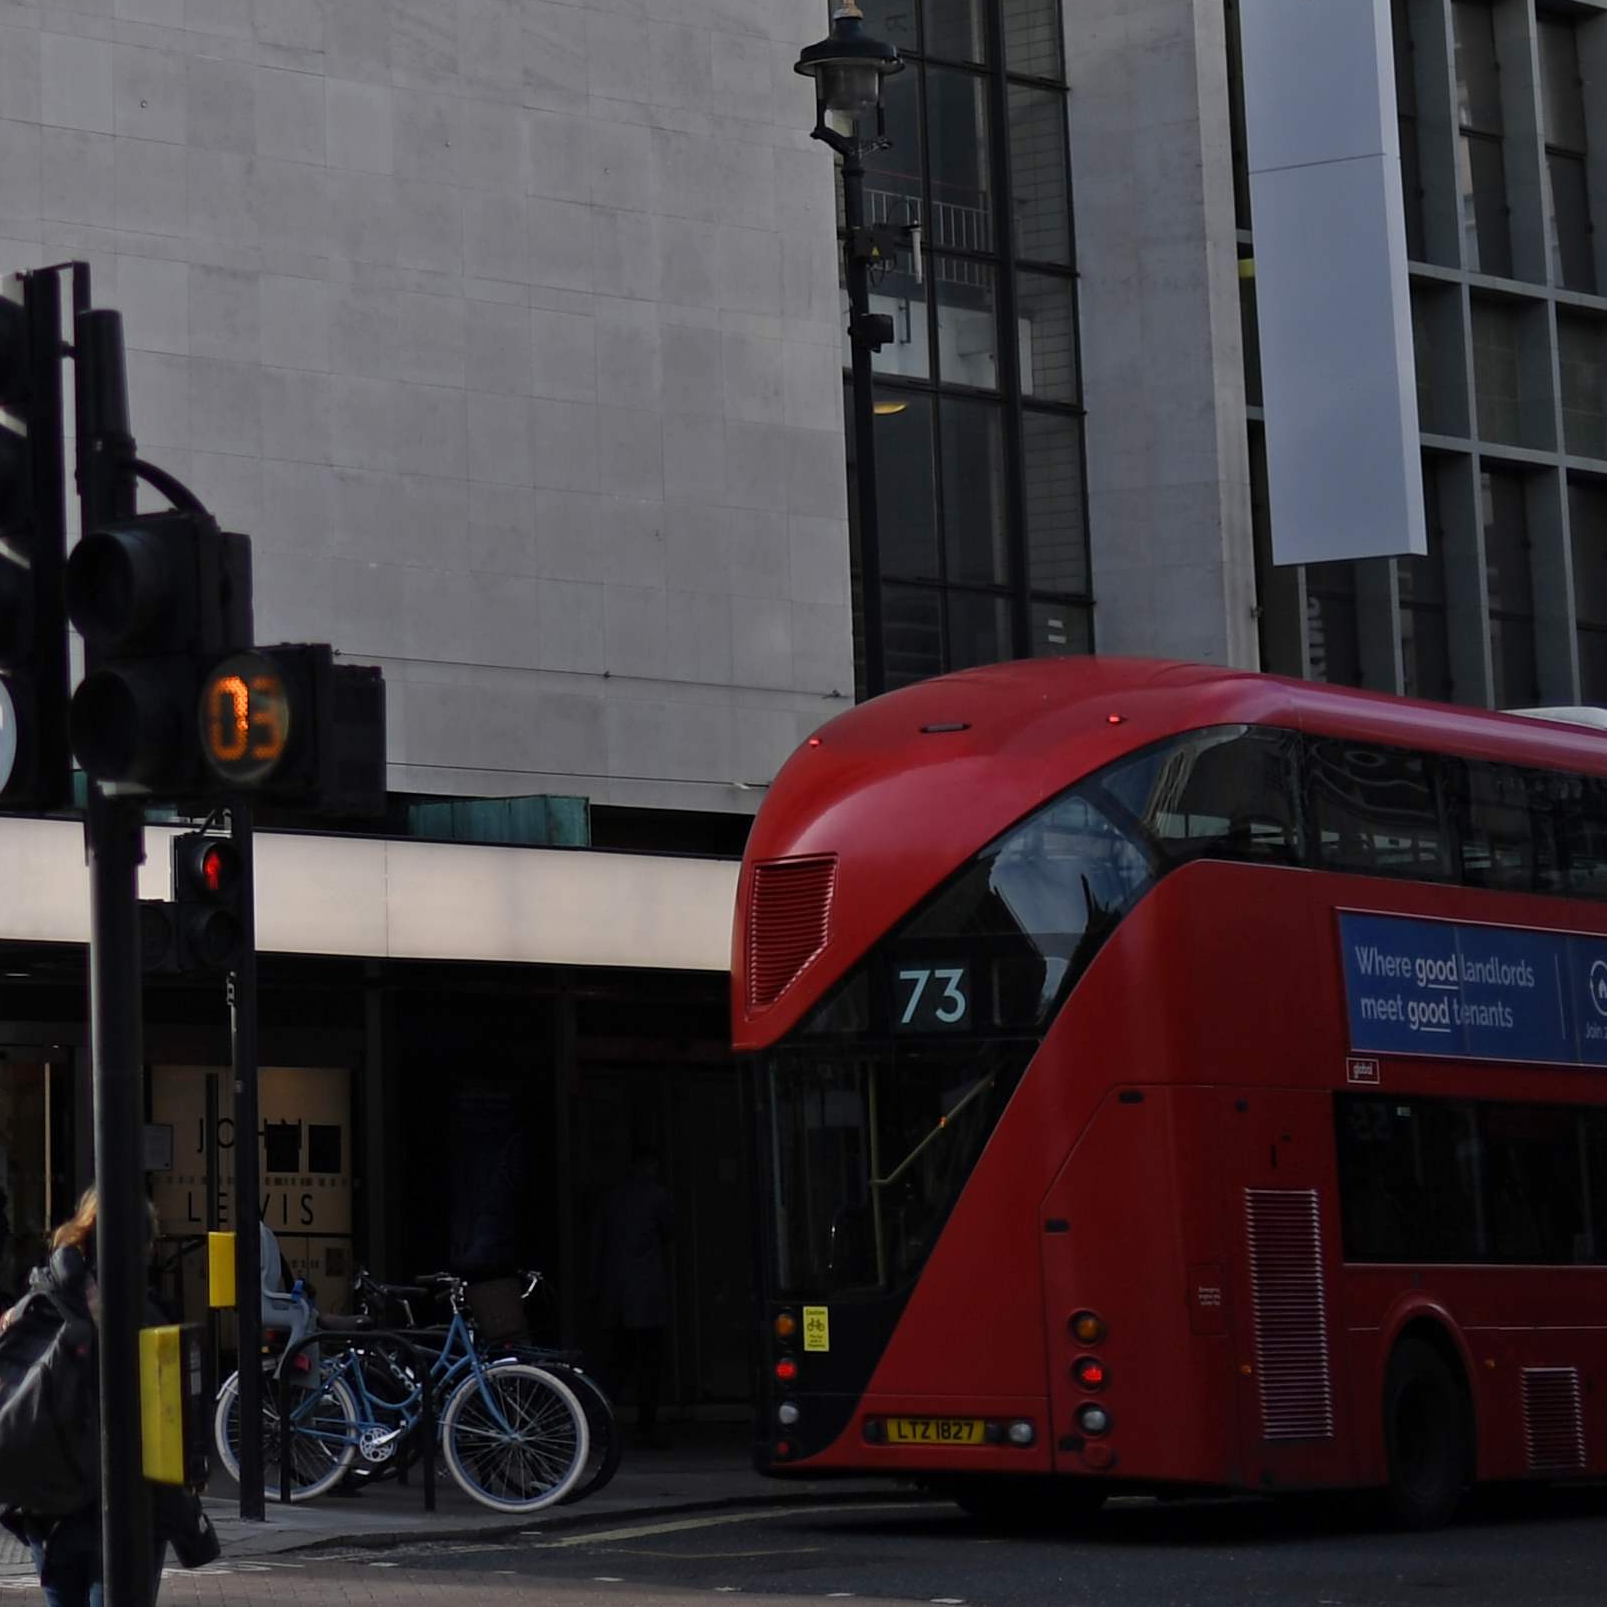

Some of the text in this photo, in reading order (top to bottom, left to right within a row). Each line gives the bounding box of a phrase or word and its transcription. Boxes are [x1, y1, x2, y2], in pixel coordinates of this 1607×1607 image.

[1355, 945, 1535, 988] Where good landlords
[899, 968, 966, 1024] 73
[1360, 994, 1514, 1030] meet good tenants
[897, 1420, 975, 1441] LTZ 1827
